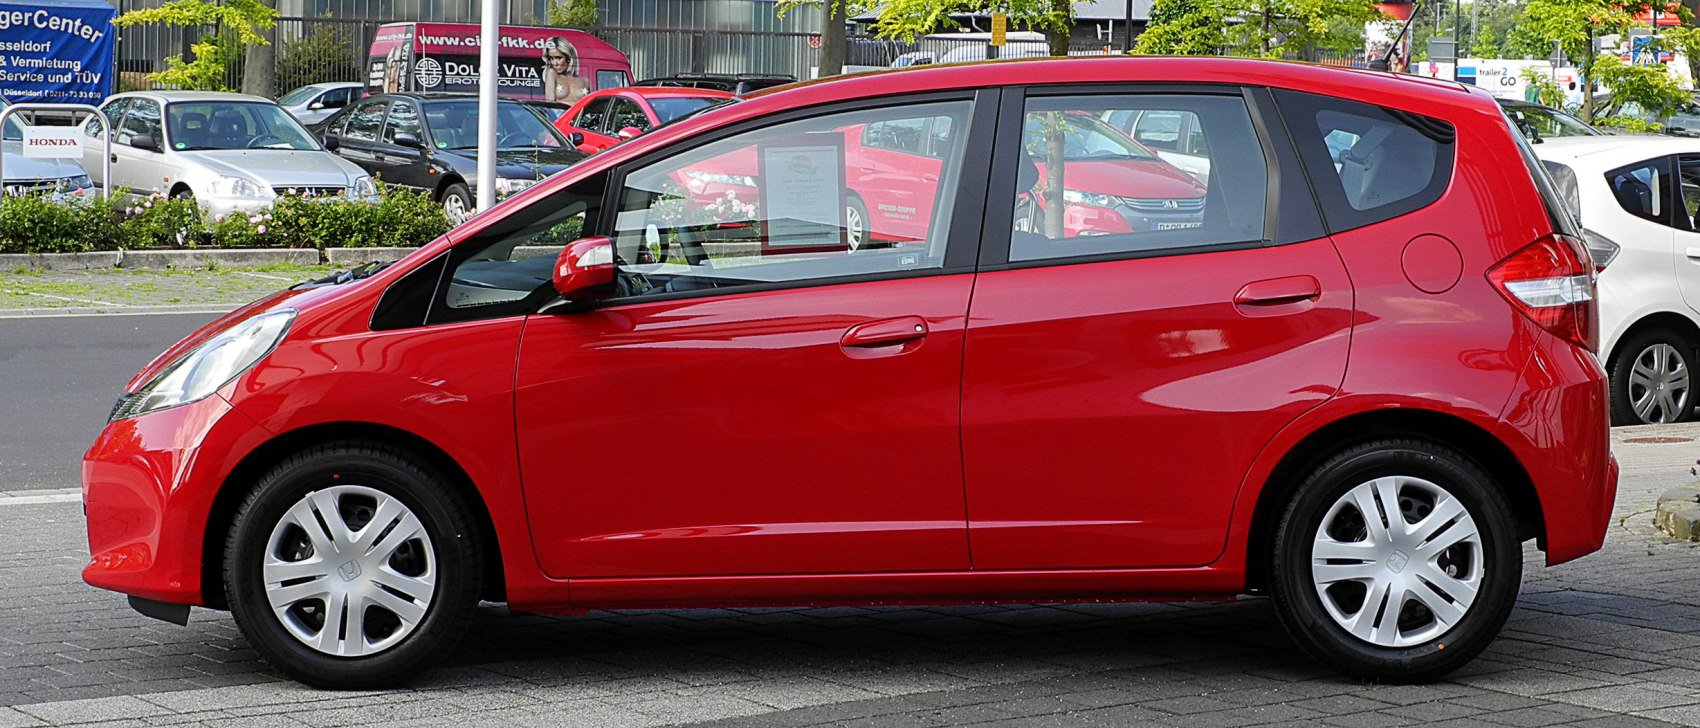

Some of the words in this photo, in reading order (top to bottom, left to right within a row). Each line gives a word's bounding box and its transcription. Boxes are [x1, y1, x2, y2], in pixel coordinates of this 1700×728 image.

[10, 56, 81, 72] Vermietung
[445, 62, 500, 77] DOL
[1502, 67, 1508, 76] 2
[0, 70, 44, 82] Service
[48, 73, 72, 83] und
[76, 71, 101, 83] TÜV
[1500, 76, 1516, 86] GO
[445, 77, 481, 85] EROT
[497, 79, 541, 87] OUNGE
[4, 88, 43, 97] Düsseldorf
[29, 138, 77, 146] HONDA
